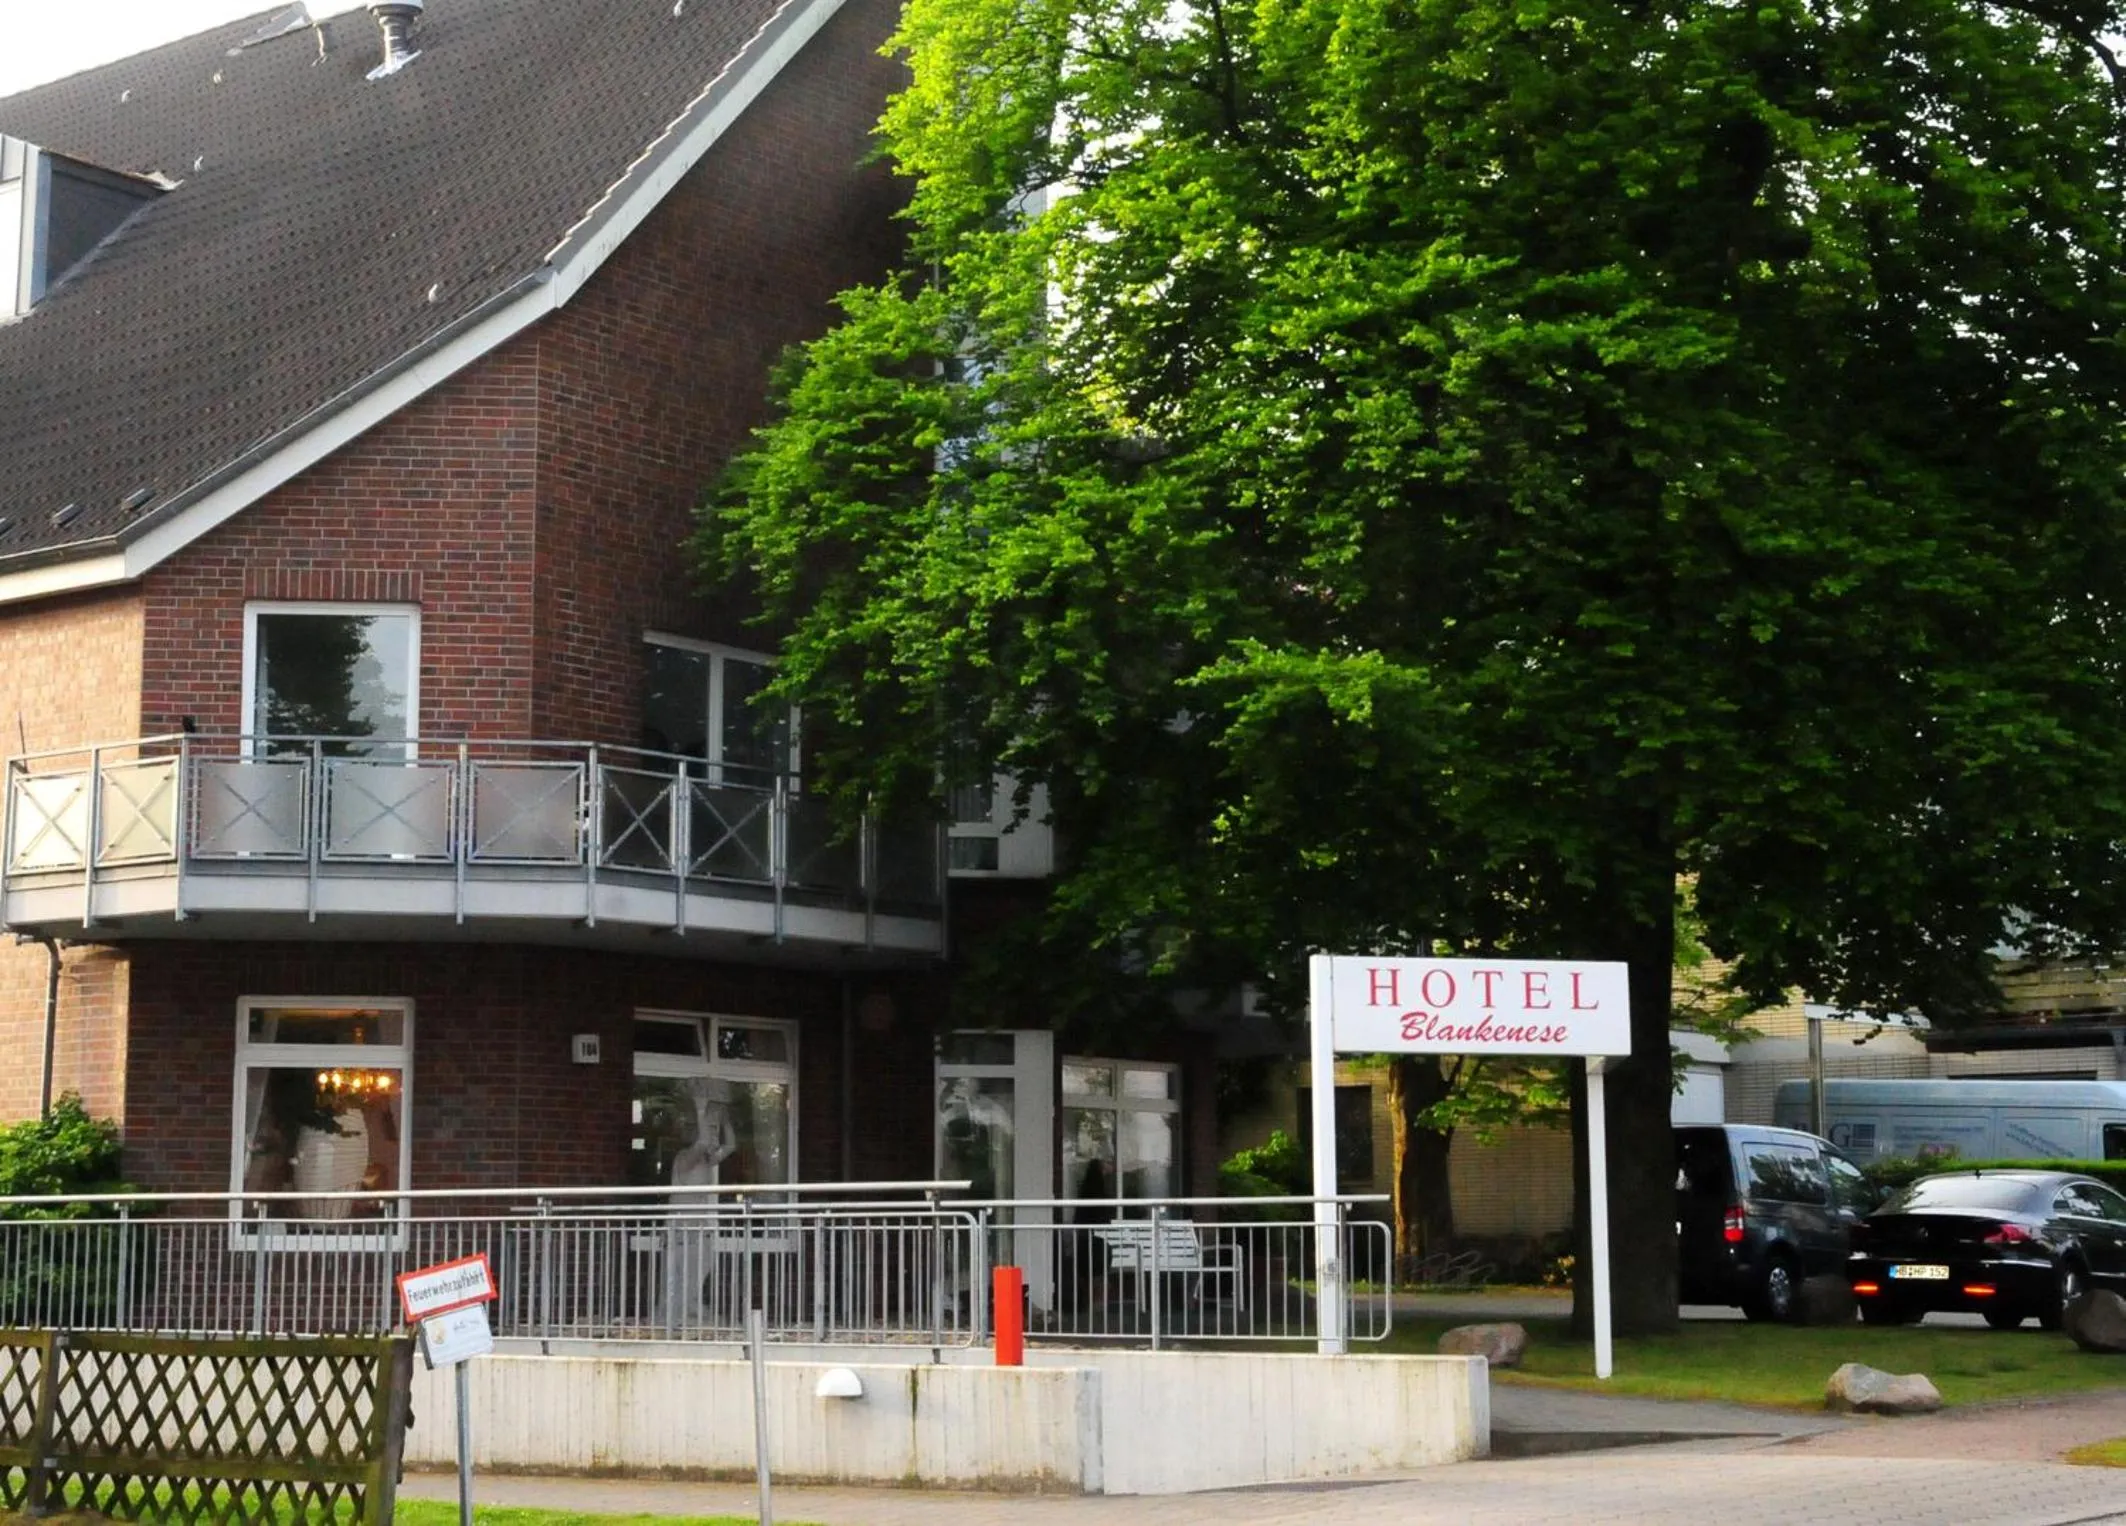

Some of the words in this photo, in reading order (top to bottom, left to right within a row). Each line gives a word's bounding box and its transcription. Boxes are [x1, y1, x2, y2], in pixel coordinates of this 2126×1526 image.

[1366, 968, 1600, 1010] HOTEL
[1400, 1011, 1568, 1043] Blankenese
[407, 1269, 485, 1301] Feuerwehrzufahrt
